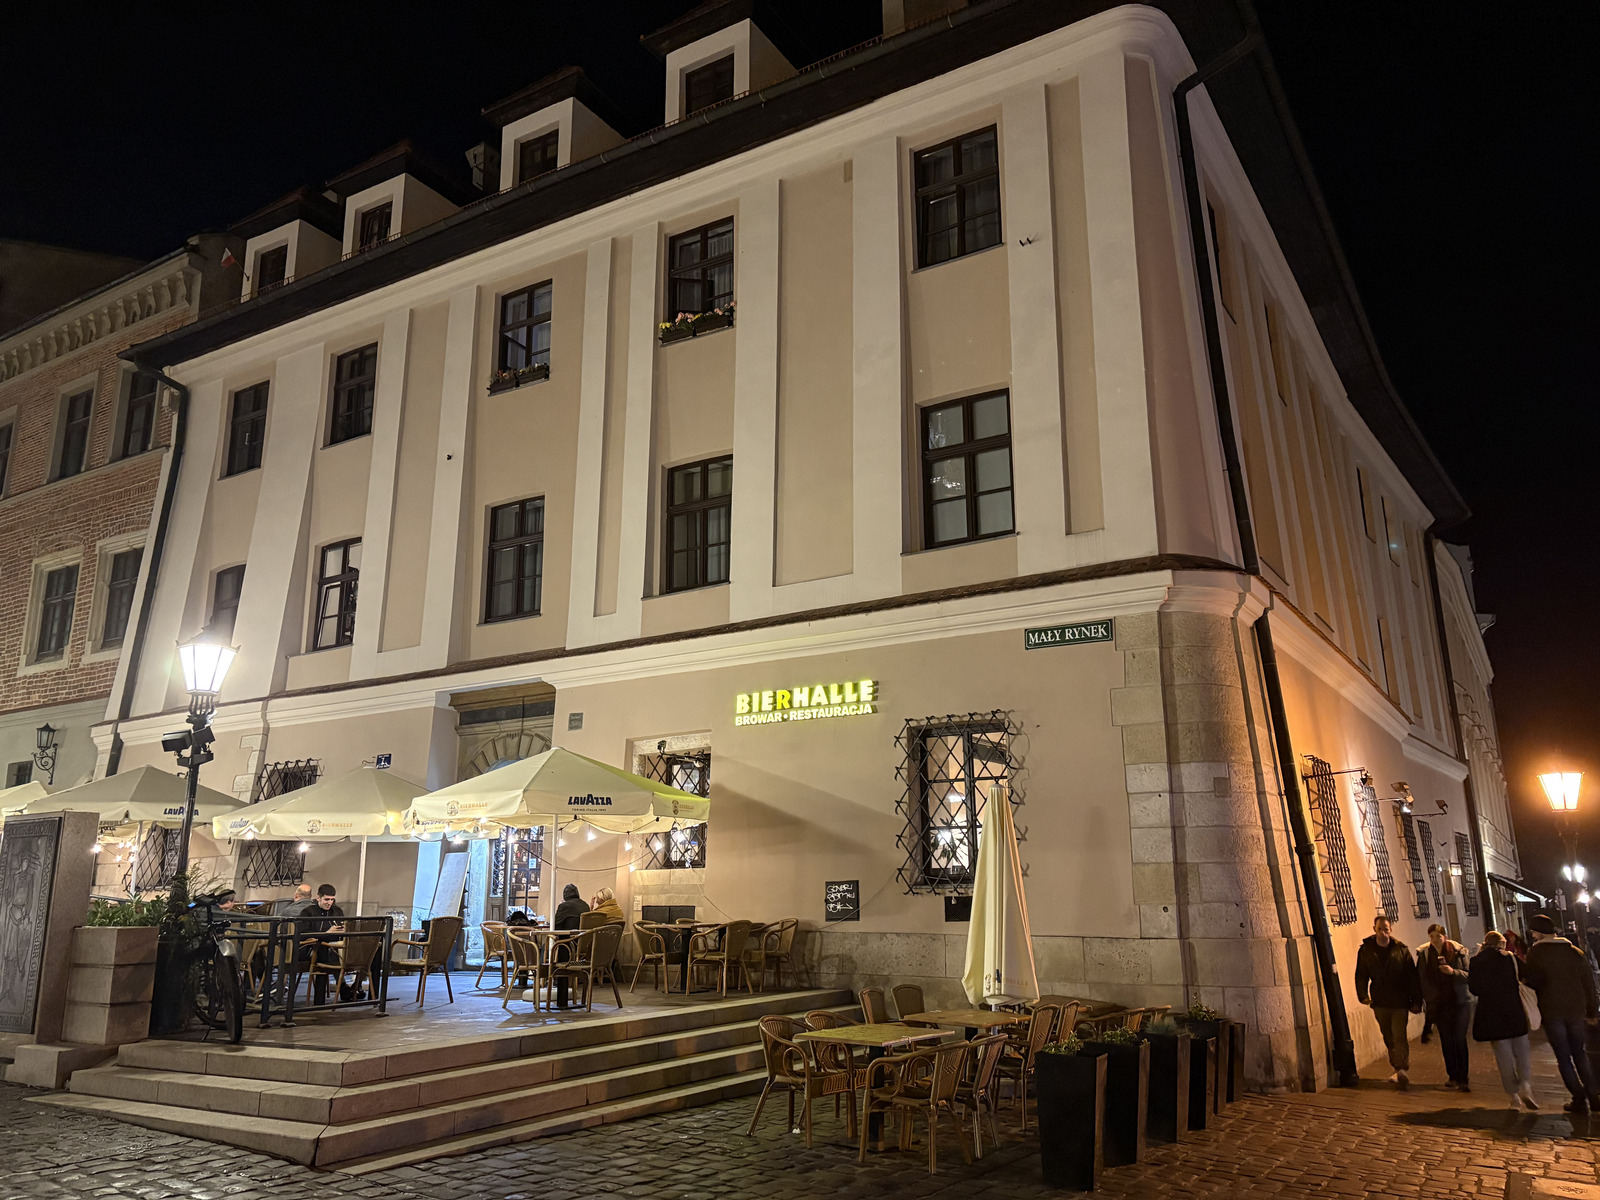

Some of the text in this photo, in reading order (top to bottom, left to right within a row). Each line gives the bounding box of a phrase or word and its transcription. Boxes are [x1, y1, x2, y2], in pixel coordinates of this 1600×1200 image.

[1028, 624, 1108, 645] MAŁY RYNEK
[736, 679, 874, 714] BIERHALLE
[735, 703, 873, 726] BROWAR RESTAURACJA
[567, 793, 613, 806] LAVAZZA
[163, 806, 199, 816] LAVAA
